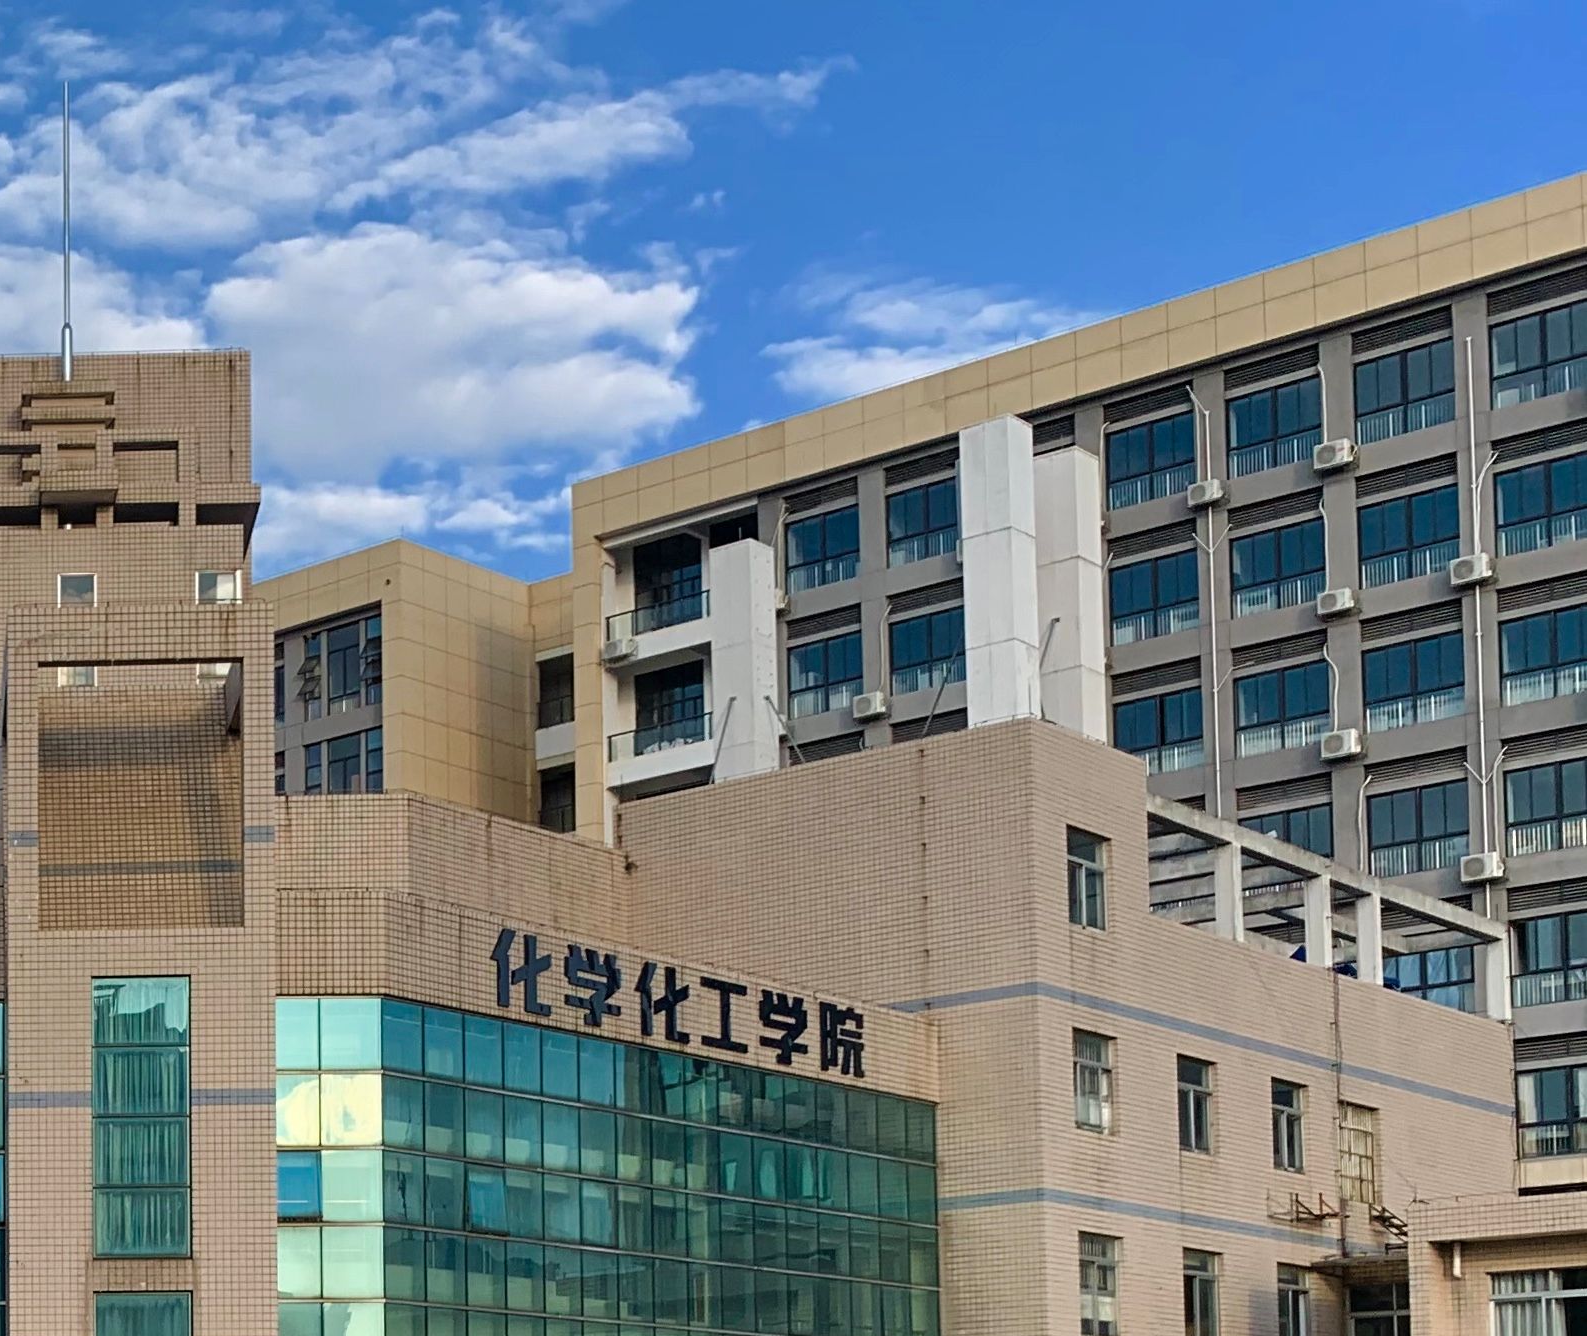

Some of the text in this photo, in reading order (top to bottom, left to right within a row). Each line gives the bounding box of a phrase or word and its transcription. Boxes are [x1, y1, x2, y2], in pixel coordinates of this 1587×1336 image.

[489, 928, 865, 1079] 化学化工学院
